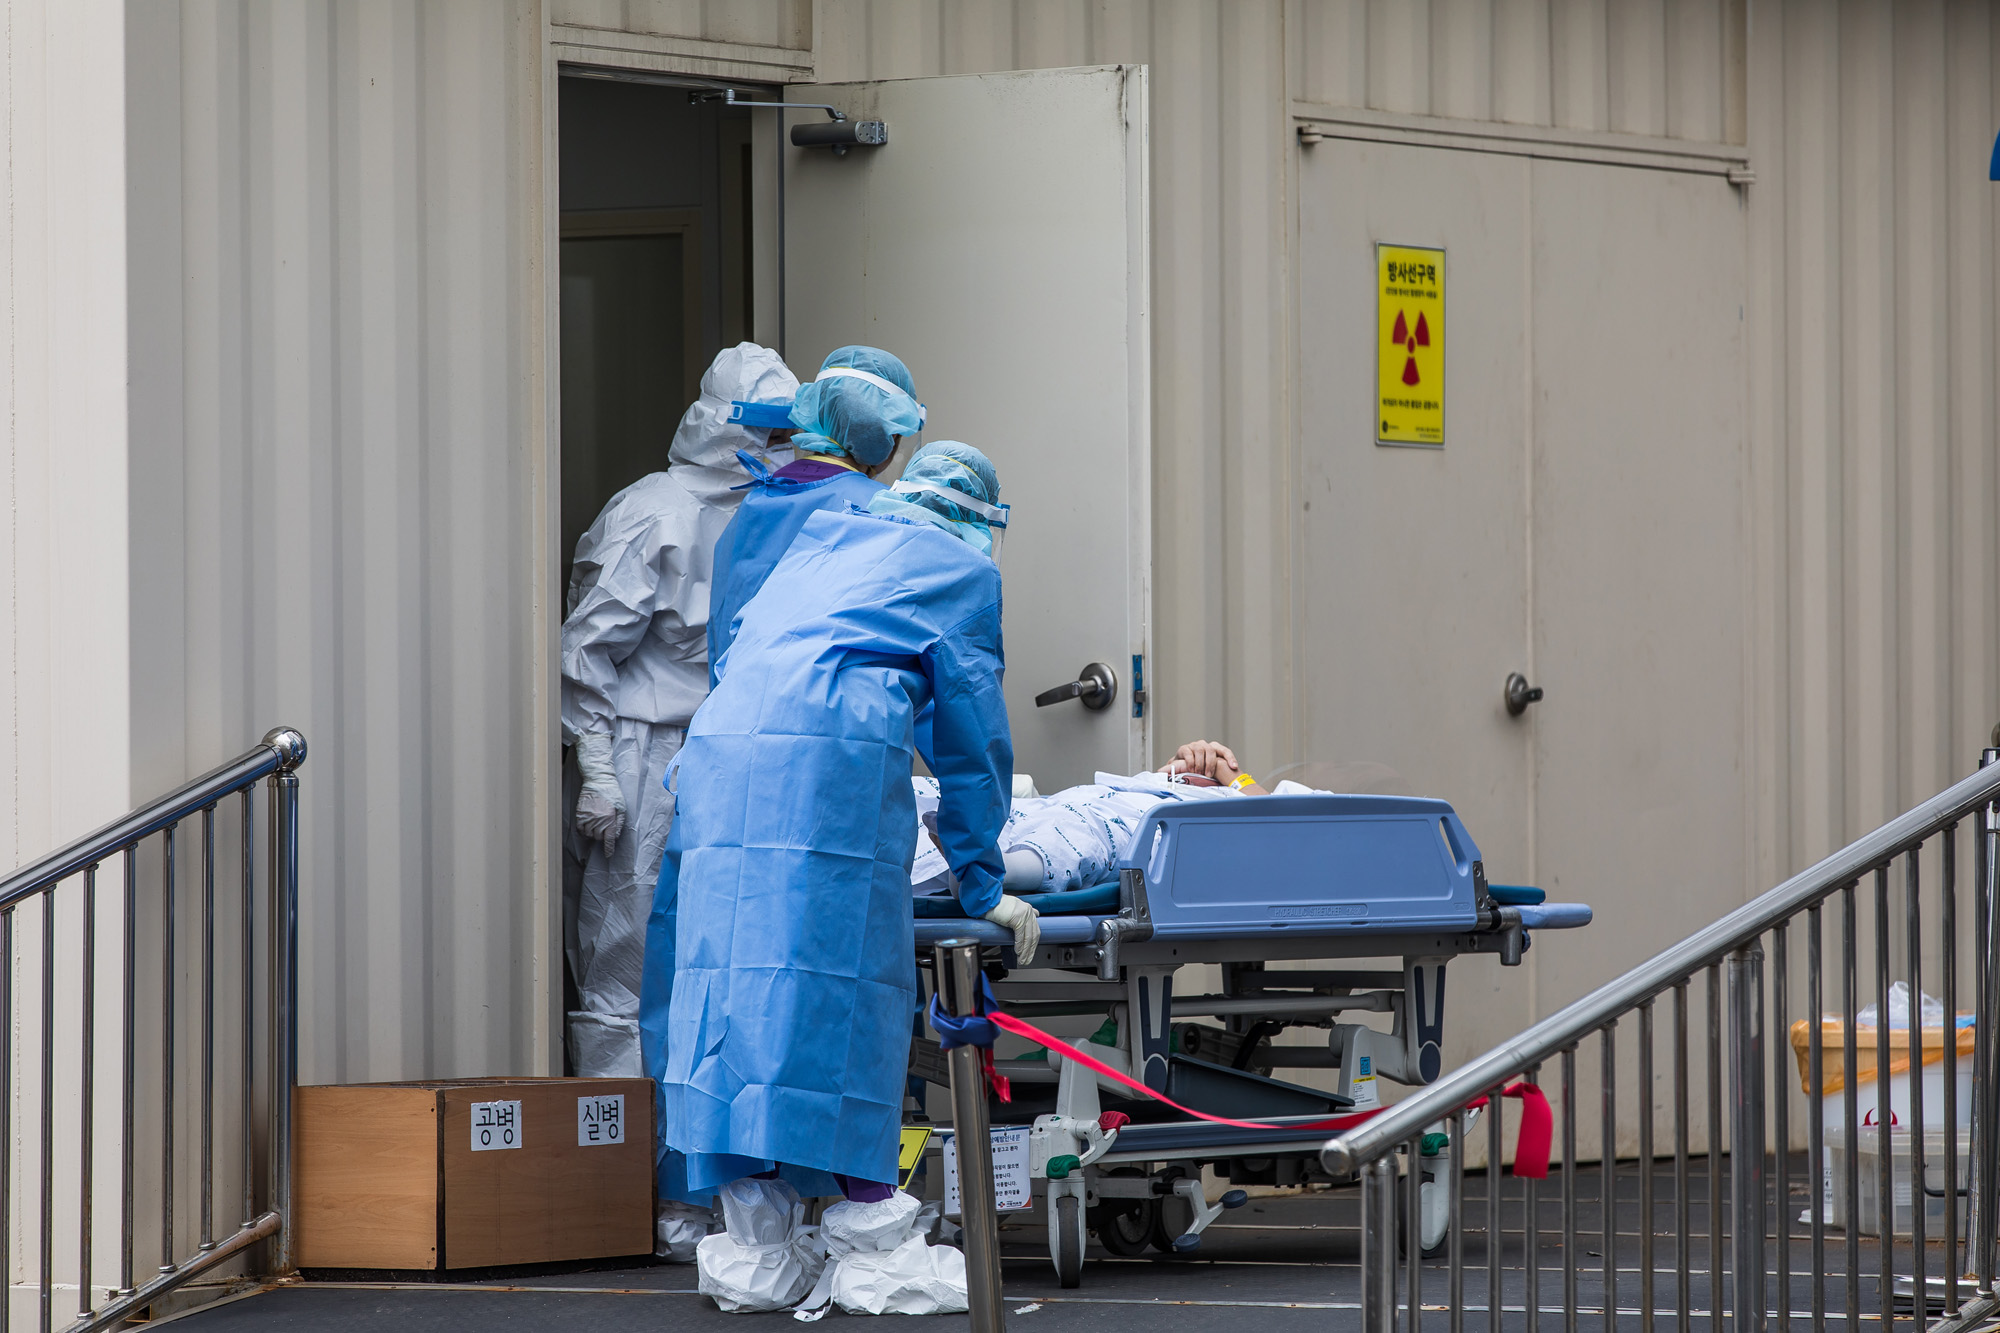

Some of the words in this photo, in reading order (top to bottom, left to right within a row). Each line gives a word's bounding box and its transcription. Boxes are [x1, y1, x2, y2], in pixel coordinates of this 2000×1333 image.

[1387, 261, 1436, 286] 방사선구역
[476, 1105, 514, 1146] 공병
[583, 1100, 619, 1141] 실병
